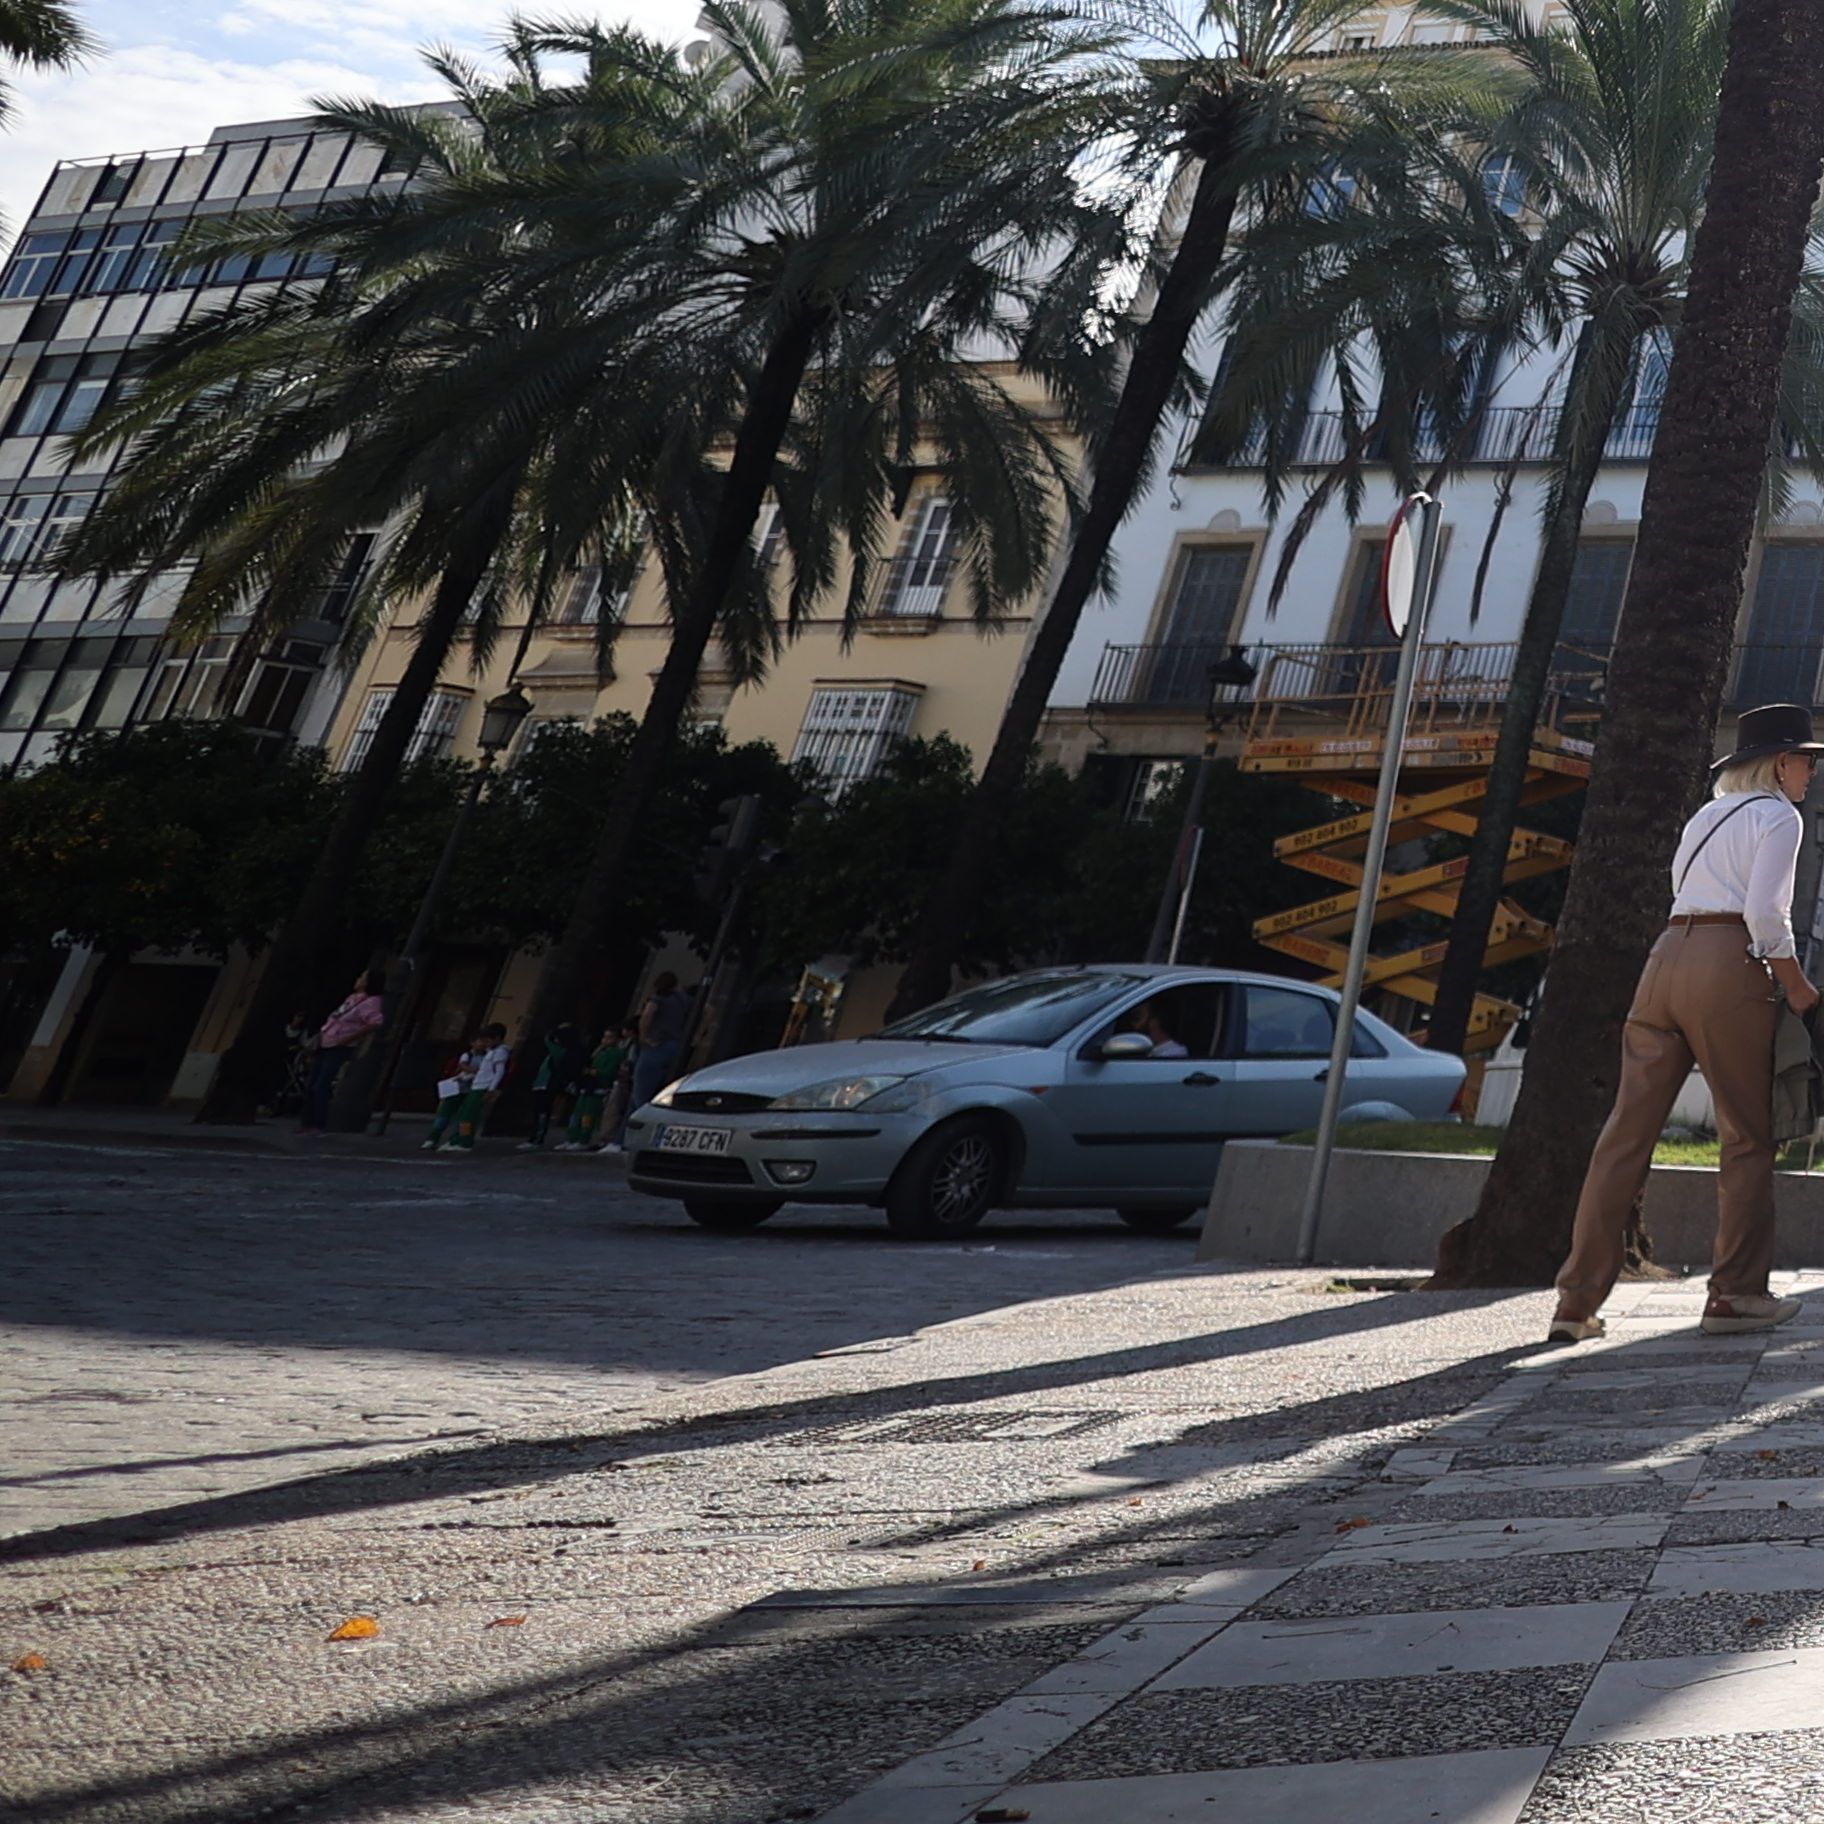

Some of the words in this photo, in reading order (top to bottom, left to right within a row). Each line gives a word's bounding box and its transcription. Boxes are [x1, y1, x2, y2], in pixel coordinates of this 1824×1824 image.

[1317, 901, 1339, 915] 902
[663, 1128, 698, 1148] 9287
[698, 1131, 727, 1152] CFN
